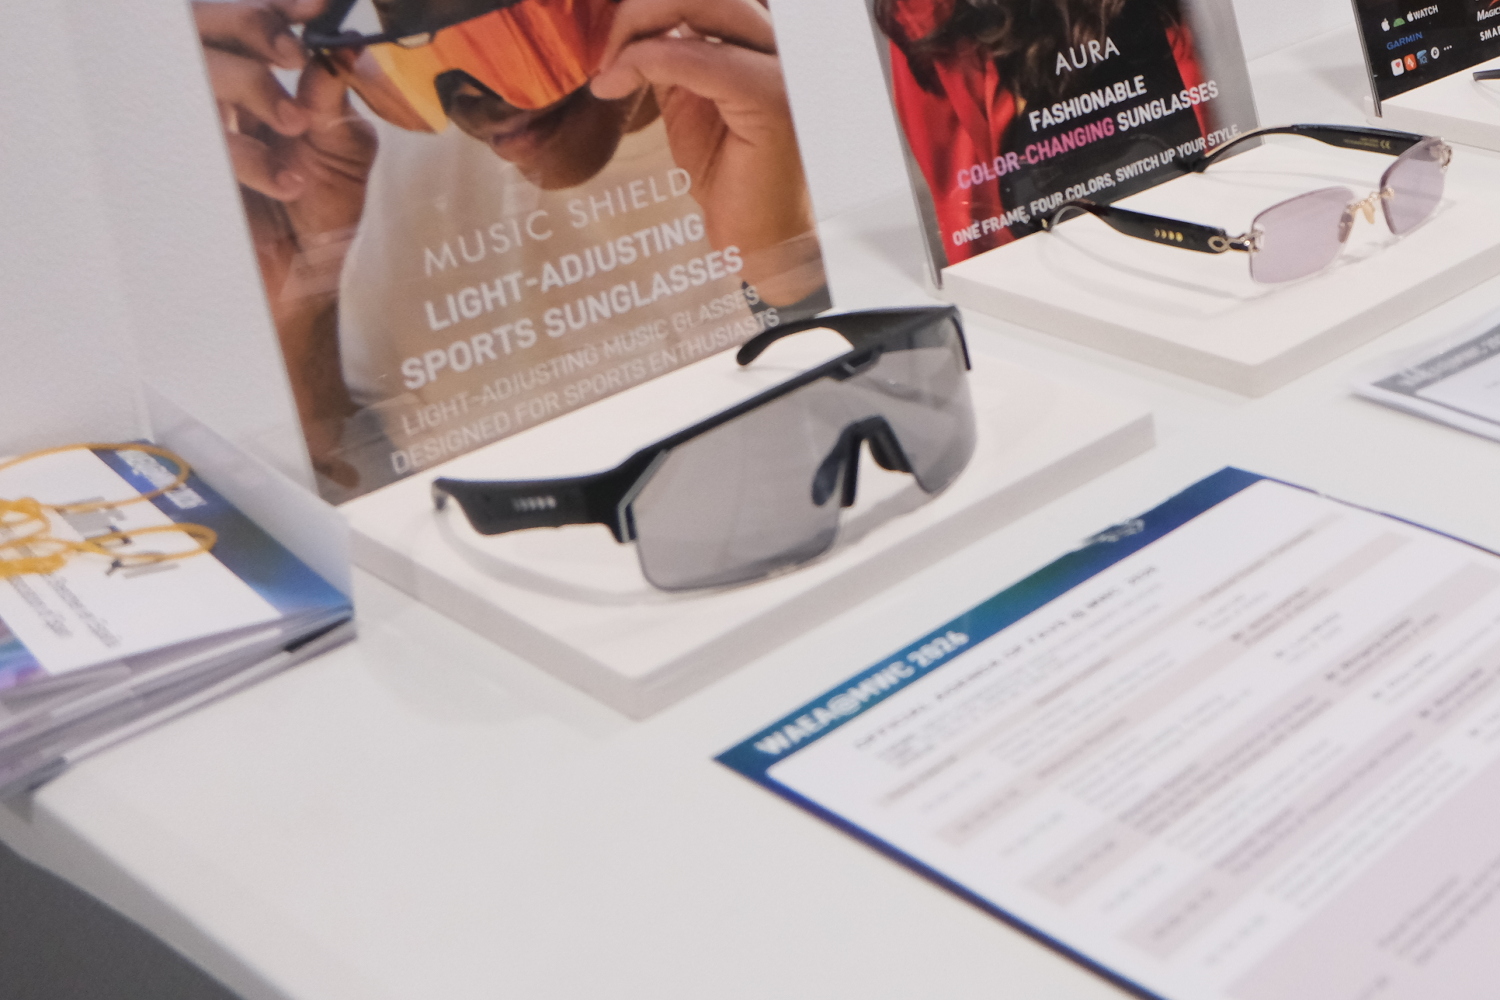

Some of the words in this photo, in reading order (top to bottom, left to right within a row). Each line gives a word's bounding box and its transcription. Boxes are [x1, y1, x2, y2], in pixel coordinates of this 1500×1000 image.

[1055, 36, 1120, 76] AURA
[1386, 32, 1423, 50] GARMIN
[1412, 4, 1439, 20] WATCH
[956, 117, 1115, 190] COLOR-CHANGING
[1117, 80, 1219, 132] SUNGLASSES
[1028, 75, 1147, 132] FASHIONABLE
[423, 209, 554, 276] MUSIC
[569, 167, 692, 229] SHIELD
[952, 226, 981, 247] ONE
[982, 209, 1030, 234] FRAME,
[1030, 192, 1064, 215] FOUR
[1064, 173, 1116, 202] COLORS,
[1116, 155, 1159, 183] SWITCH
[1160, 147, 1176, 167] UP
[1176, 137, 1207, 161] YOUR
[402, 318, 537, 389] SPORTS
[546, 246, 743, 339] SUNGLASSES
[424, 213, 705, 331] LIGHT-ADJUSTING
[391, 409, 511, 474] DESIGNED
[514, 389, 561, 426] FOR
[565, 360, 645, 406] SPORTS
[649, 307, 780, 376] ENTHUSIASTS
[402, 343, 600, 435] LIGHT-ADJUSTING
[604, 317, 669, 355] MUSIC
[673, 285, 760, 330] GLASSES
[906, 630, 970, 668] 2026
